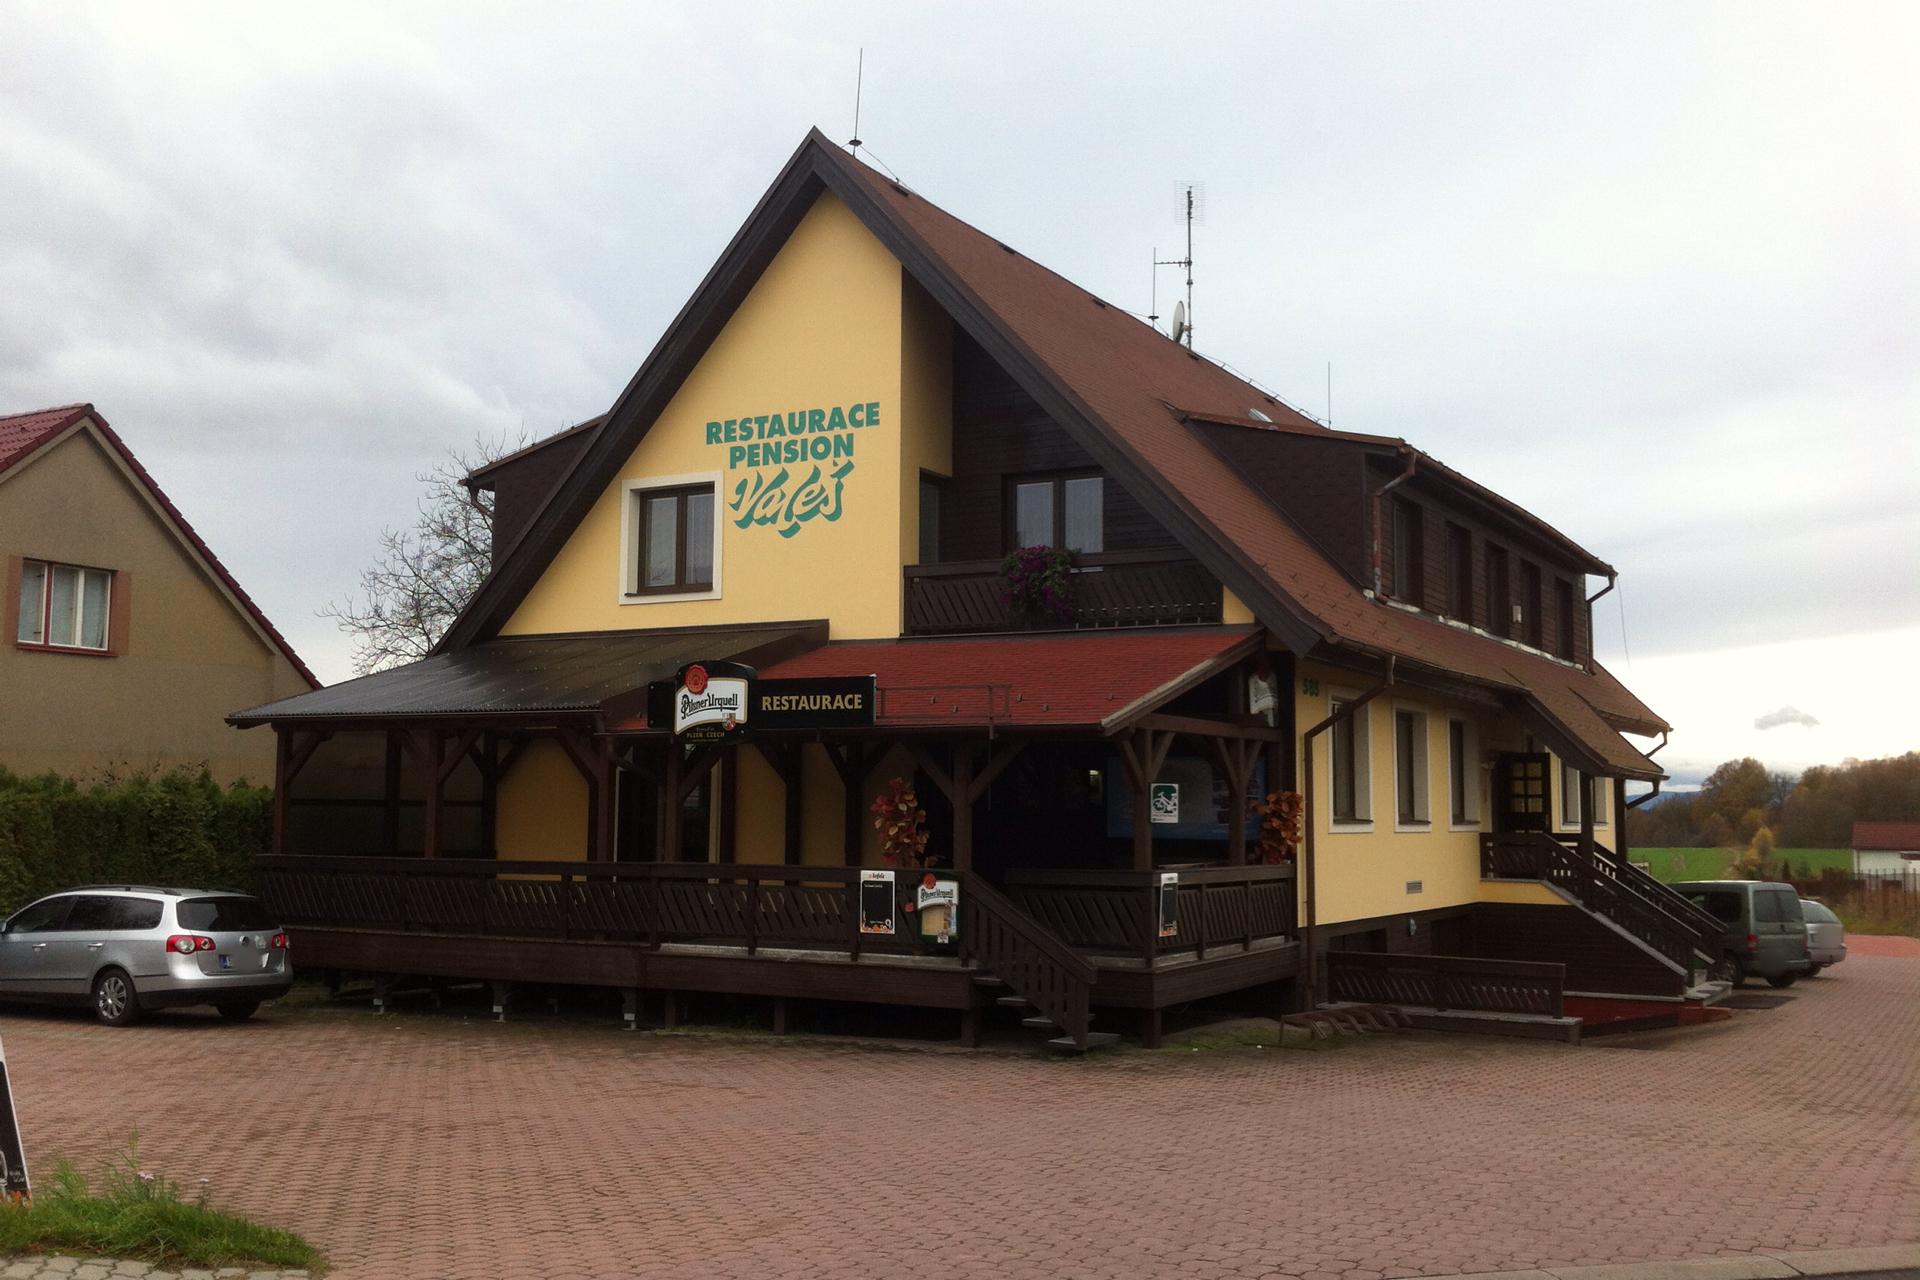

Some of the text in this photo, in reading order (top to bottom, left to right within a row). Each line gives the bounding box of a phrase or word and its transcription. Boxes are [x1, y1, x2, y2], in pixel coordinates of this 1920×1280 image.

[706, 401, 880, 445] RESTAURACE
[729, 433, 854, 469] PENSION
[681, 692, 738, 720] Pilsner Urquell
[761, 693, 863, 712] RESTAURACE
